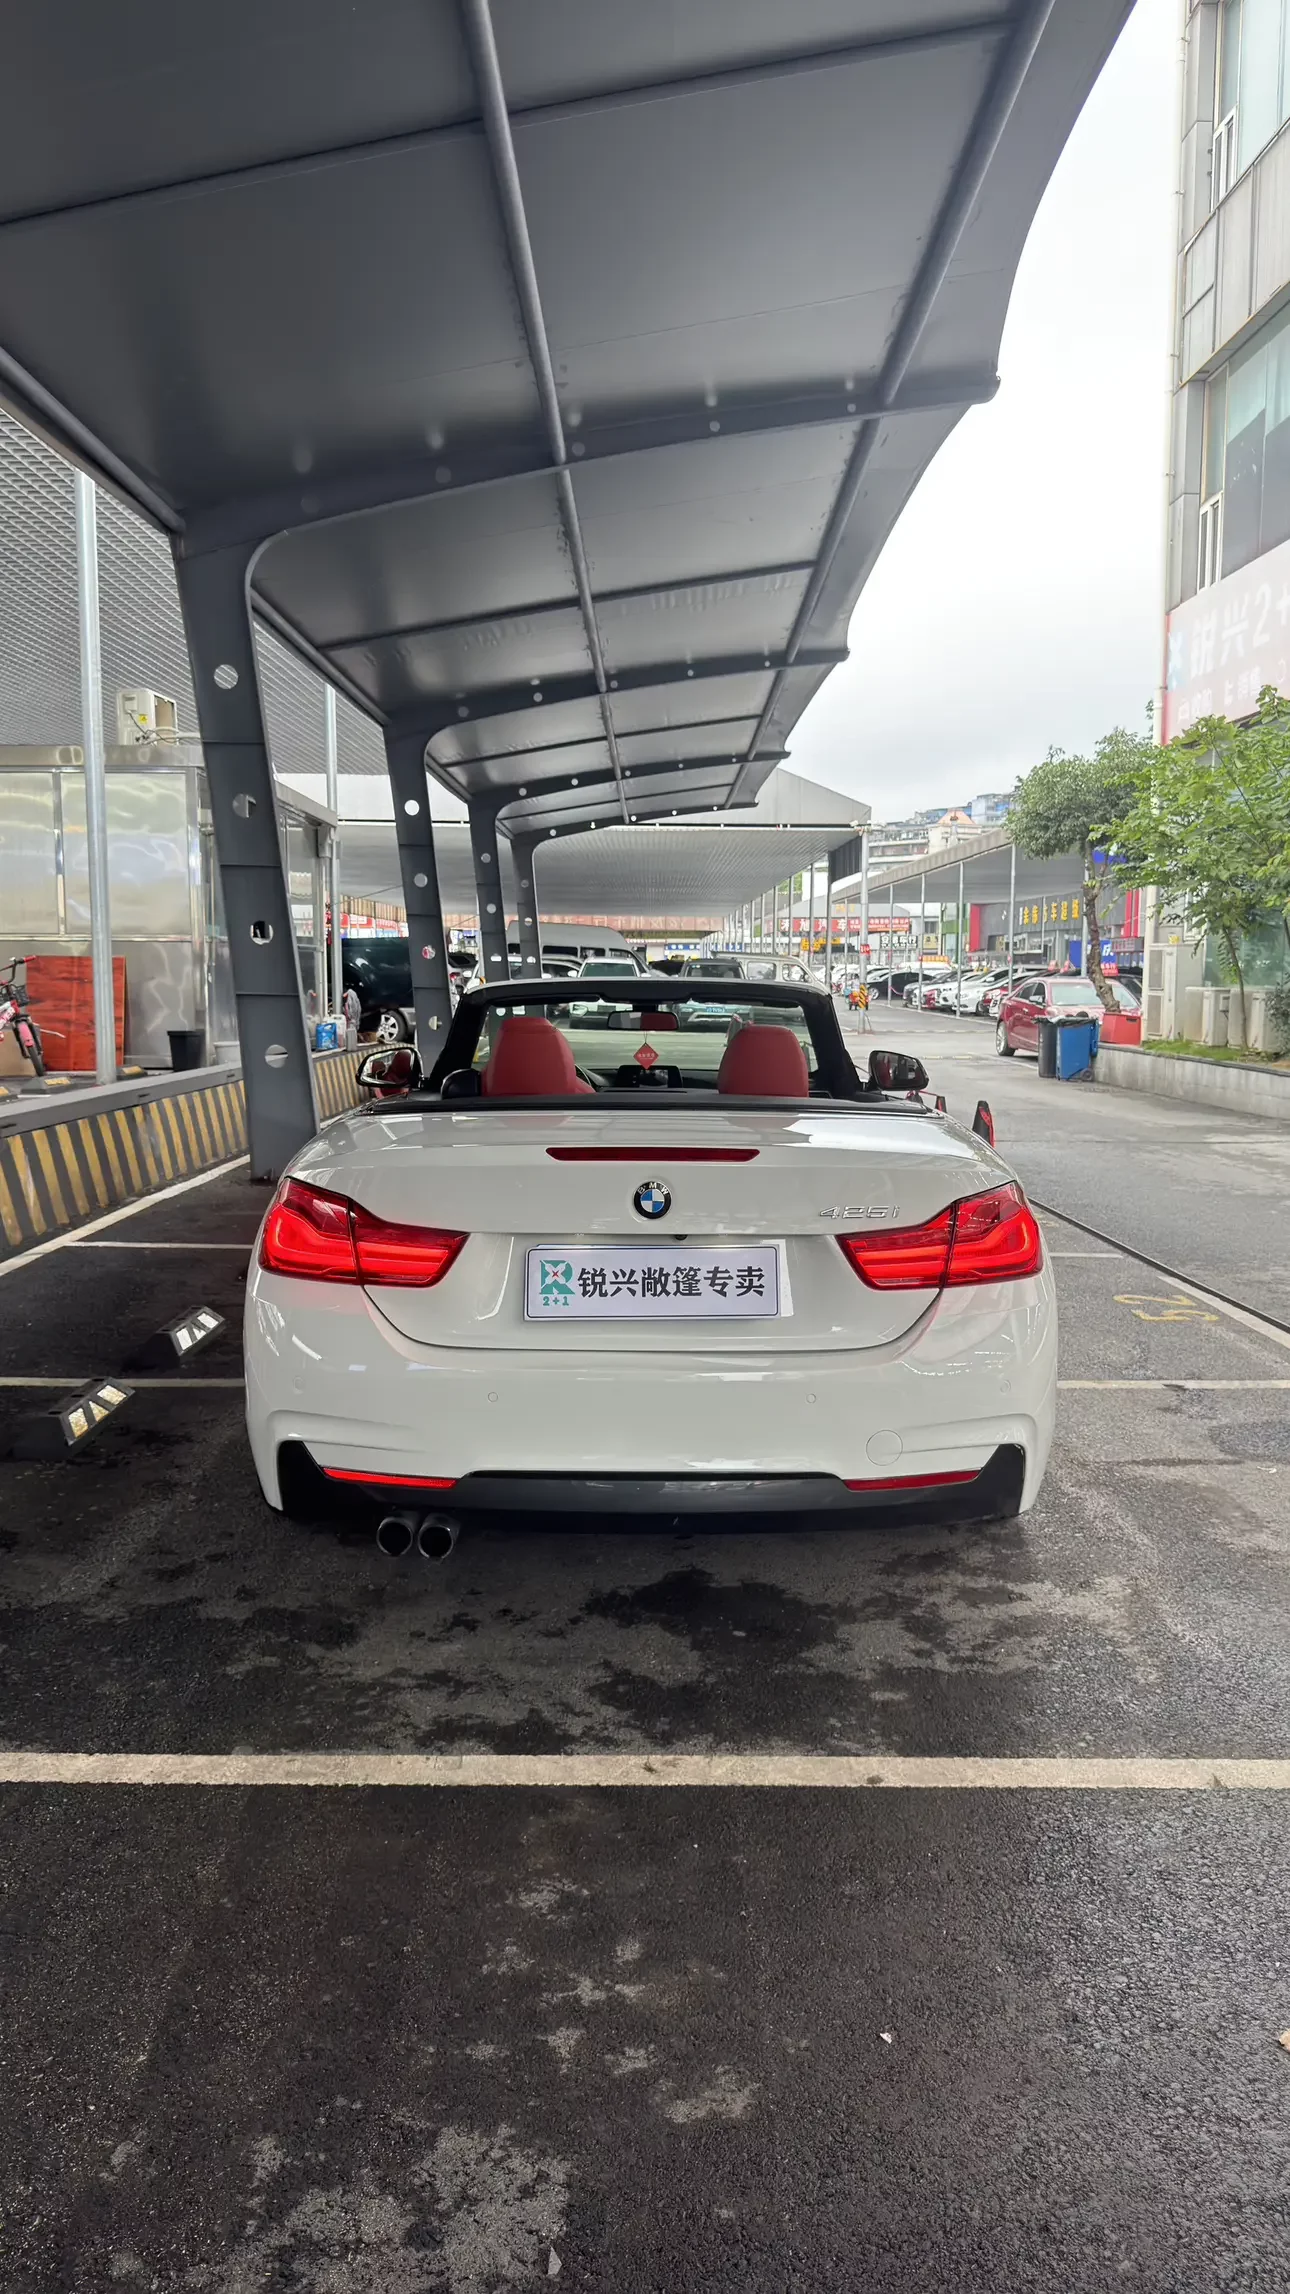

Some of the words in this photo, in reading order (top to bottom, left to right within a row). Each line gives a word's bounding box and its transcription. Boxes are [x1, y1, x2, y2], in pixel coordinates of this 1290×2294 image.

[819, 1205, 900, 1219] 425i
[577, 1266, 765, 1298] 锐兴敞篷专卖
